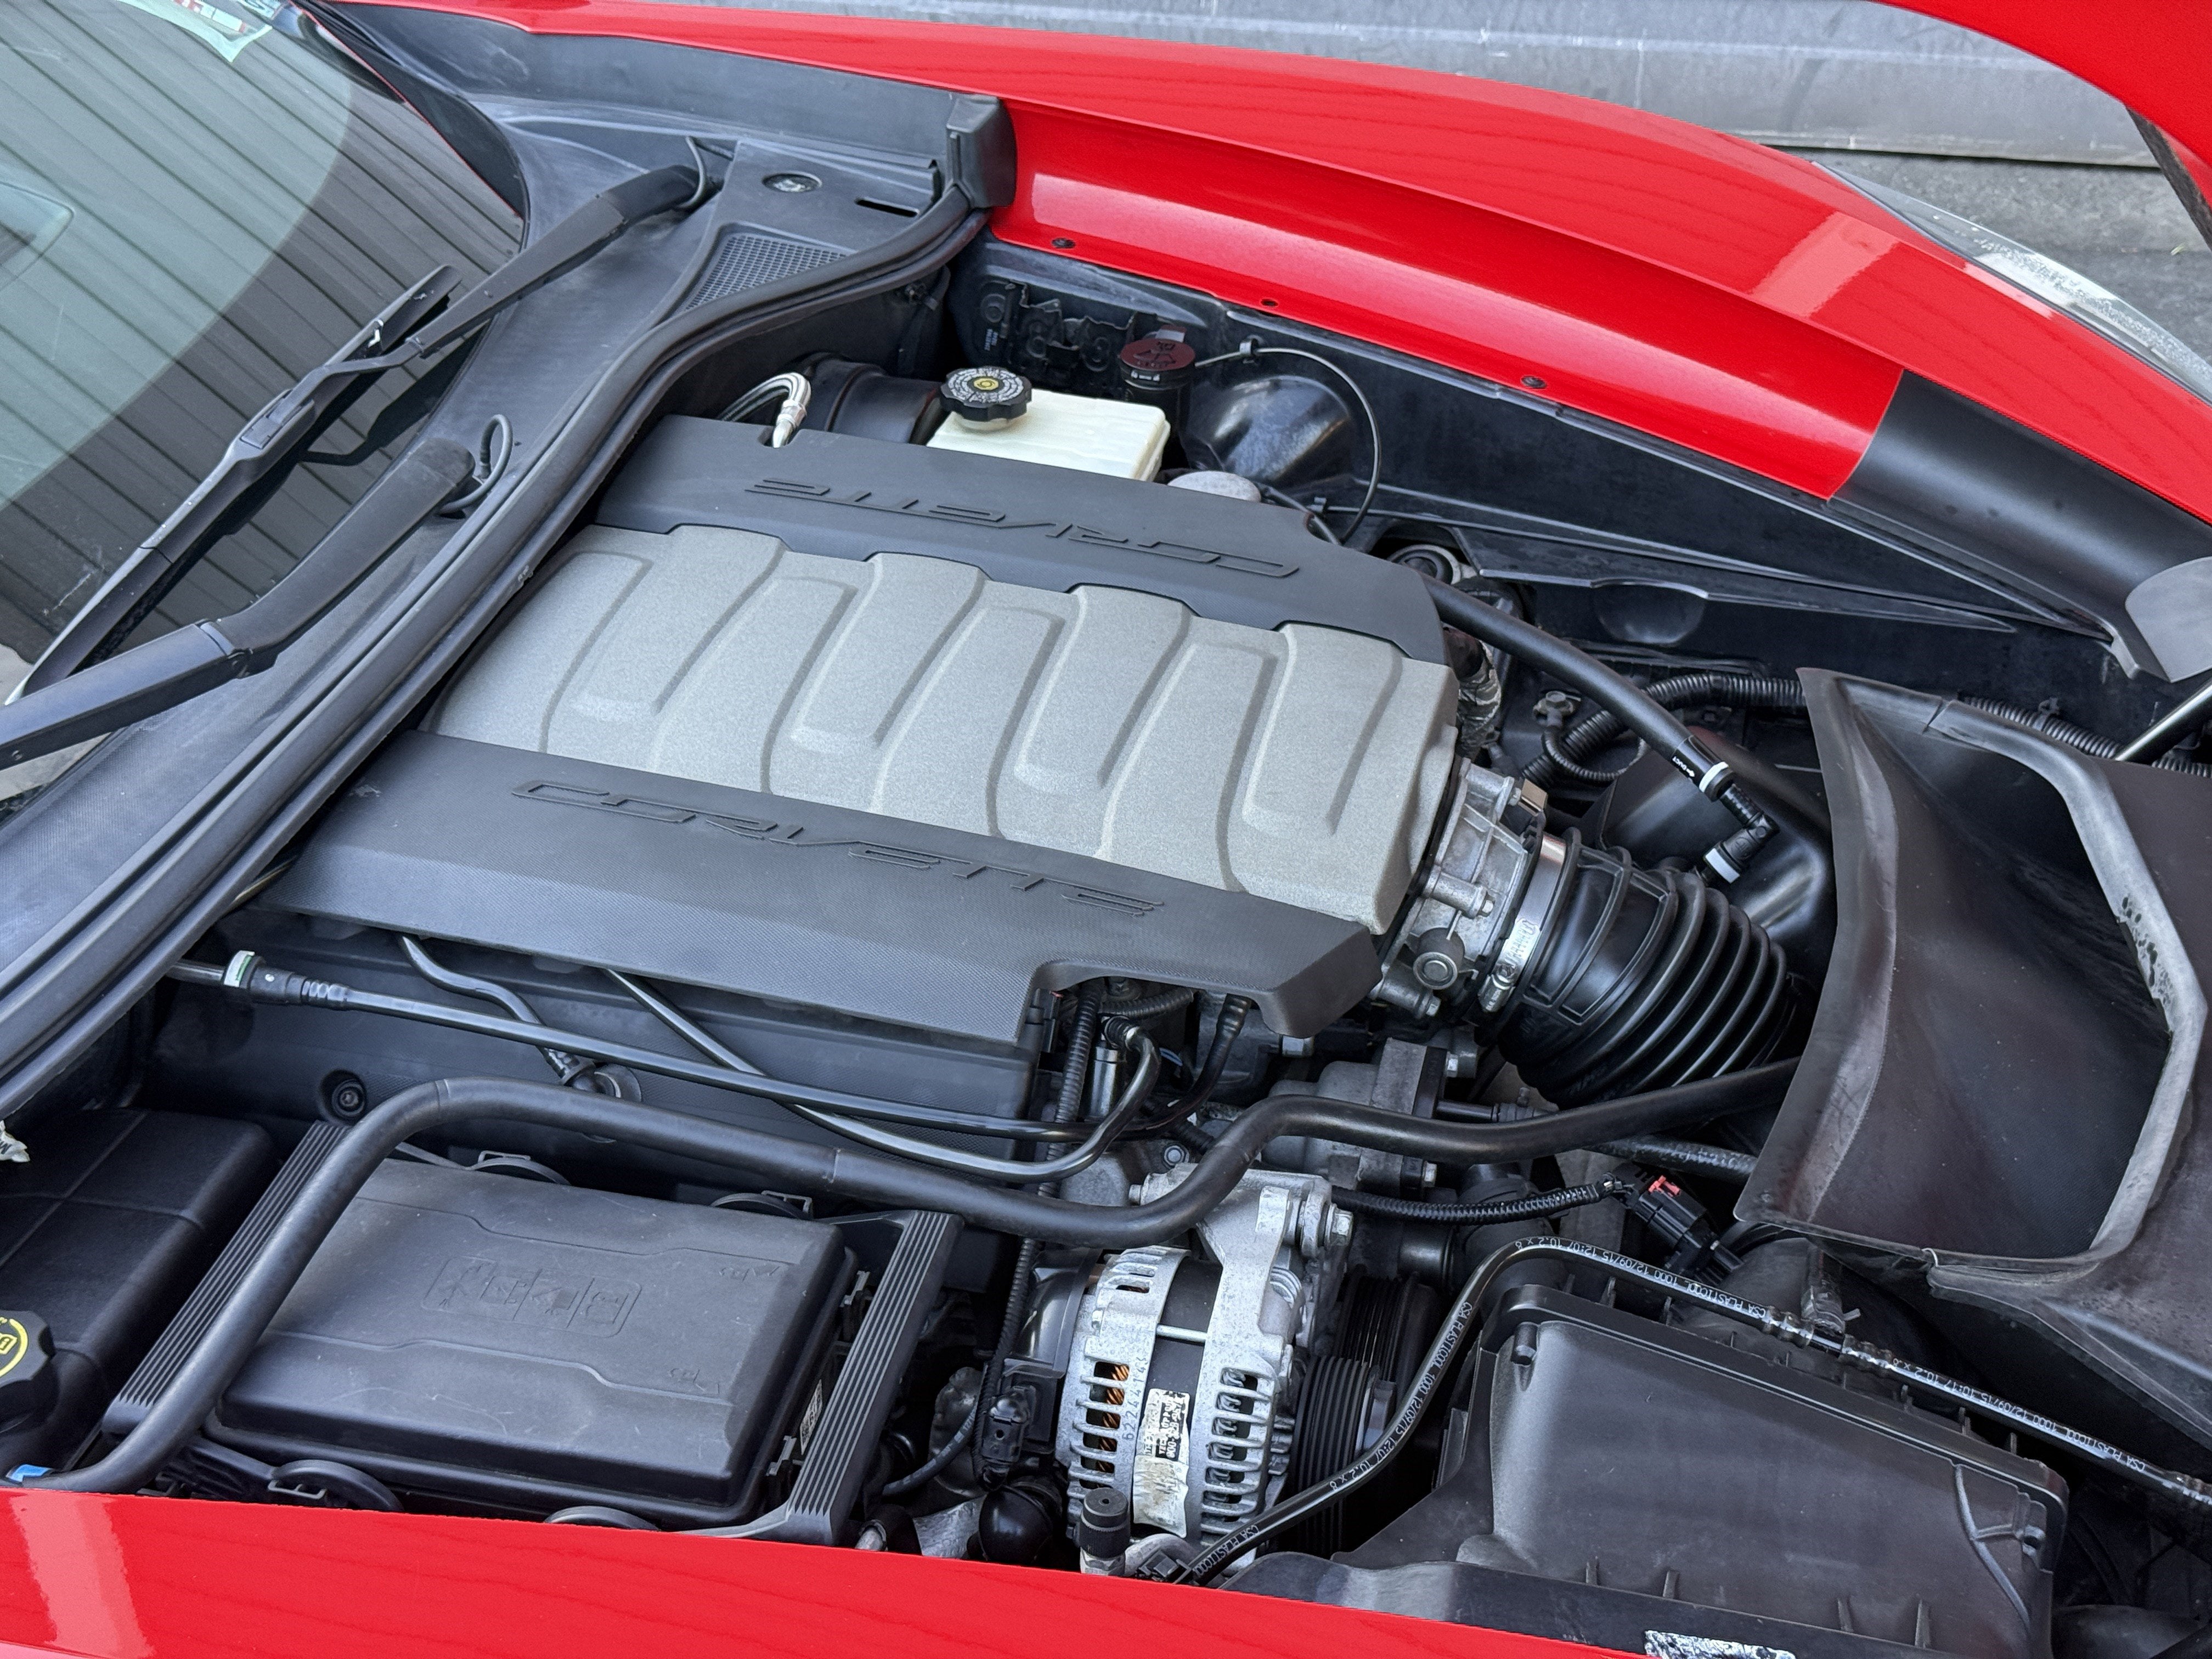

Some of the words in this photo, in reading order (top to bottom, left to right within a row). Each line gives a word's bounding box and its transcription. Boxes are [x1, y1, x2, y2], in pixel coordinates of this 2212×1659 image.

[744, 477, 1300, 578] CORVETTE
[1672, 756, 1687, 771] DUCT
[511, 778, 1165, 917] CORVETTE
[1538, 1237, 1562, 1249] 10.2
[1567, 1240, 1597, 1257] 12:07
[1601, 1250, 1649, 1275] 12/09/15
[1654, 1269, 1678, 1286] 1000
[1685, 1280, 1743, 1310] PLASTICOOL
[1459, 1301, 1472, 1319] CSA
[1747, 1303, 1766, 1318] CSA
[1432, 1319, 1465, 1369] PLASTICOOL
[1419, 1372, 1436, 1395] 1000
[1915, 1367, 1939, 1385] 10.2
[1944, 1379, 1976, 1398] 10:17
[1395, 1395, 1424, 1435] 12/09/15
[1979, 1392, 2028, 1419] 12/09/15
[2033, 1414, 2057, 1431] 1000
[1375, 1436, 1398, 1463] 12:07
[2065, 1427, 2123, 1462] PLASTICOOL
[1349, 1458, 1374, 1479] 10.2
[2126, 1455, 2145, 1472] CSA
[1329, 1481, 1338, 1491] 8
[1239, 1525, 1259, 1540] CSA
